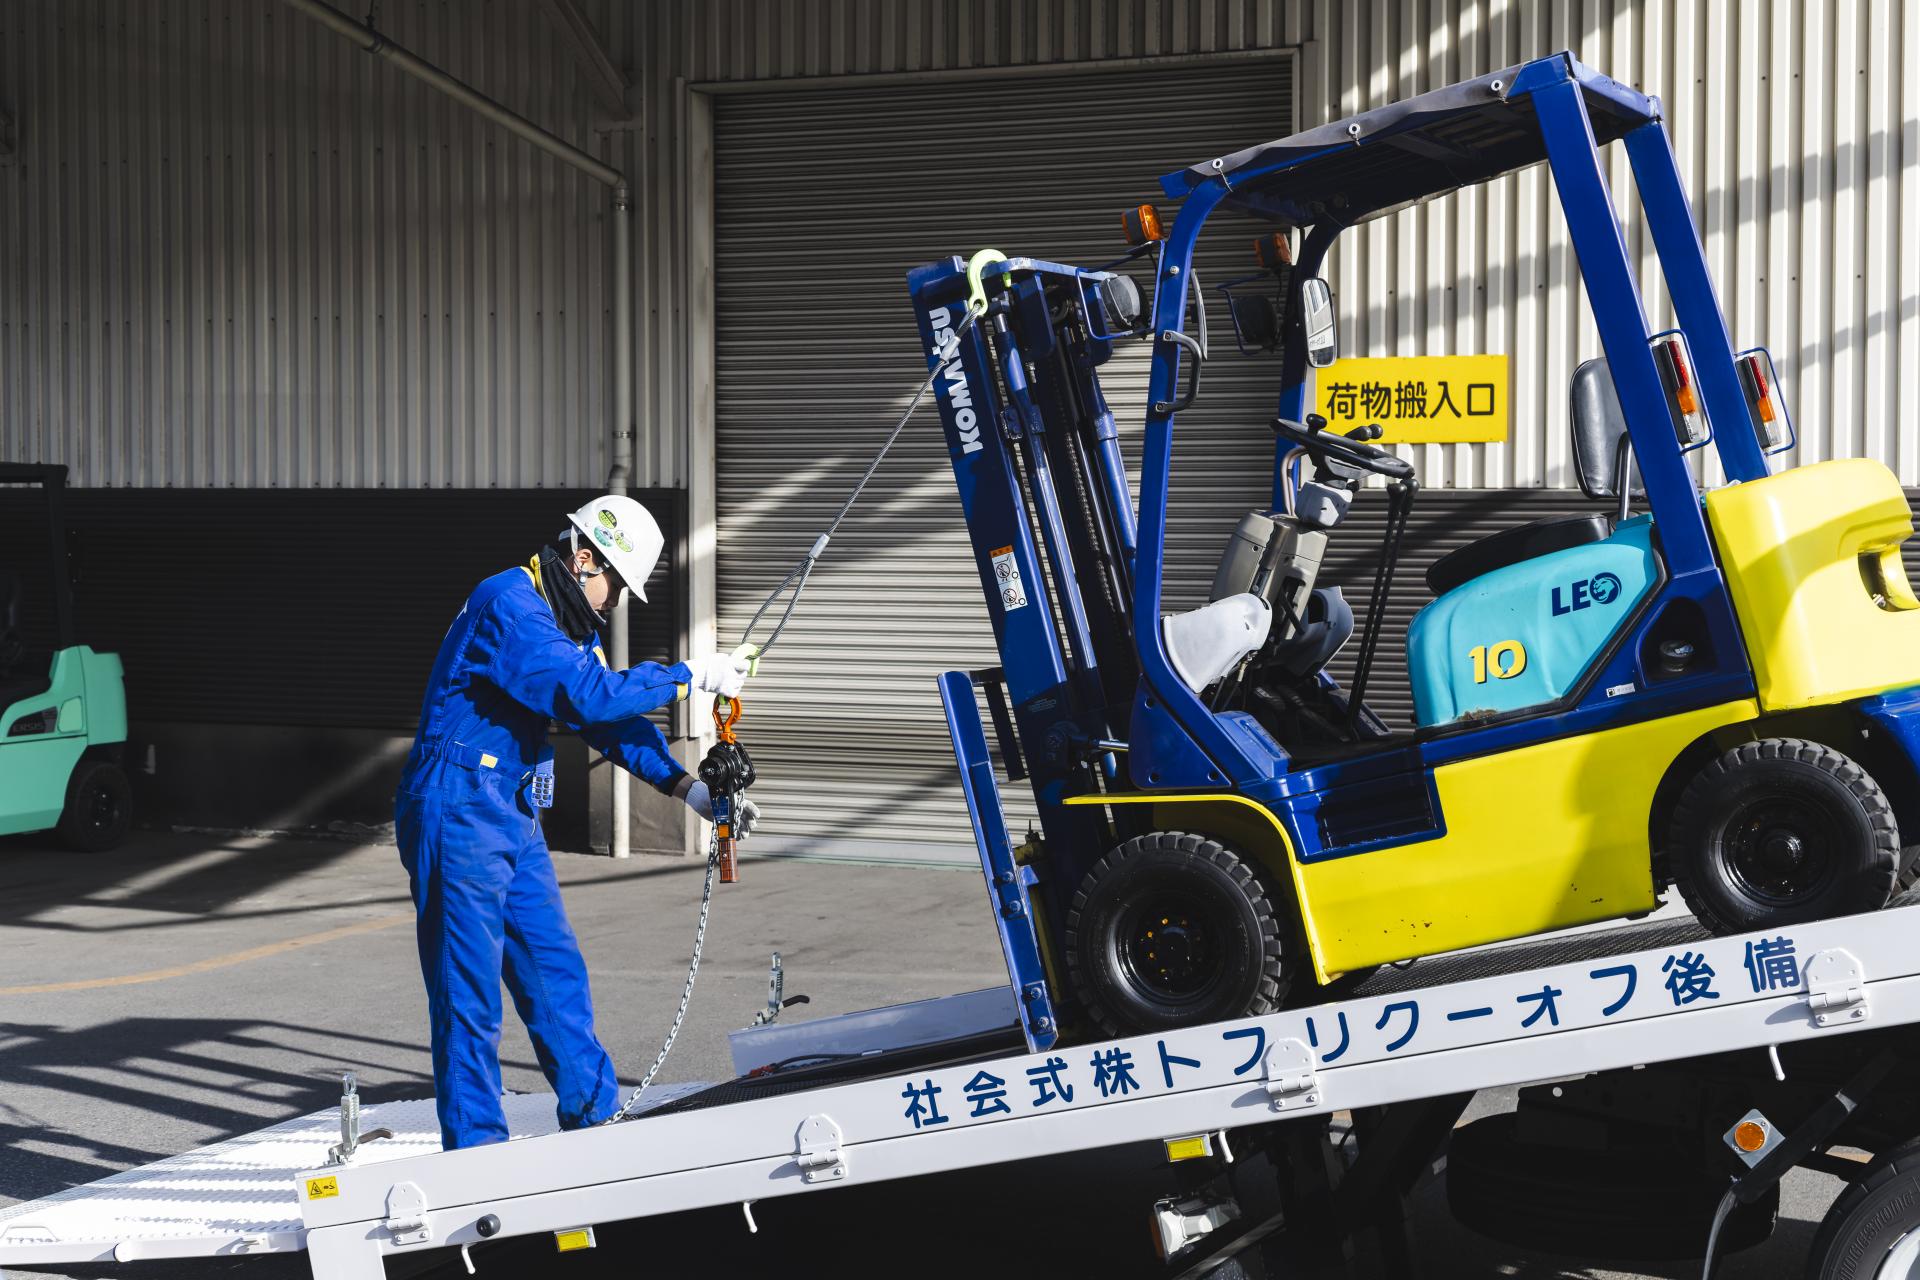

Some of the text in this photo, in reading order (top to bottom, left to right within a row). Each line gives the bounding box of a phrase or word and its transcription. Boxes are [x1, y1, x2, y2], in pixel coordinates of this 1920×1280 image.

[1326, 381, 1495, 420] 荷物搬入口
[1551, 572, 1622, 617] LEO
[1467, 639, 1528, 684] 10
